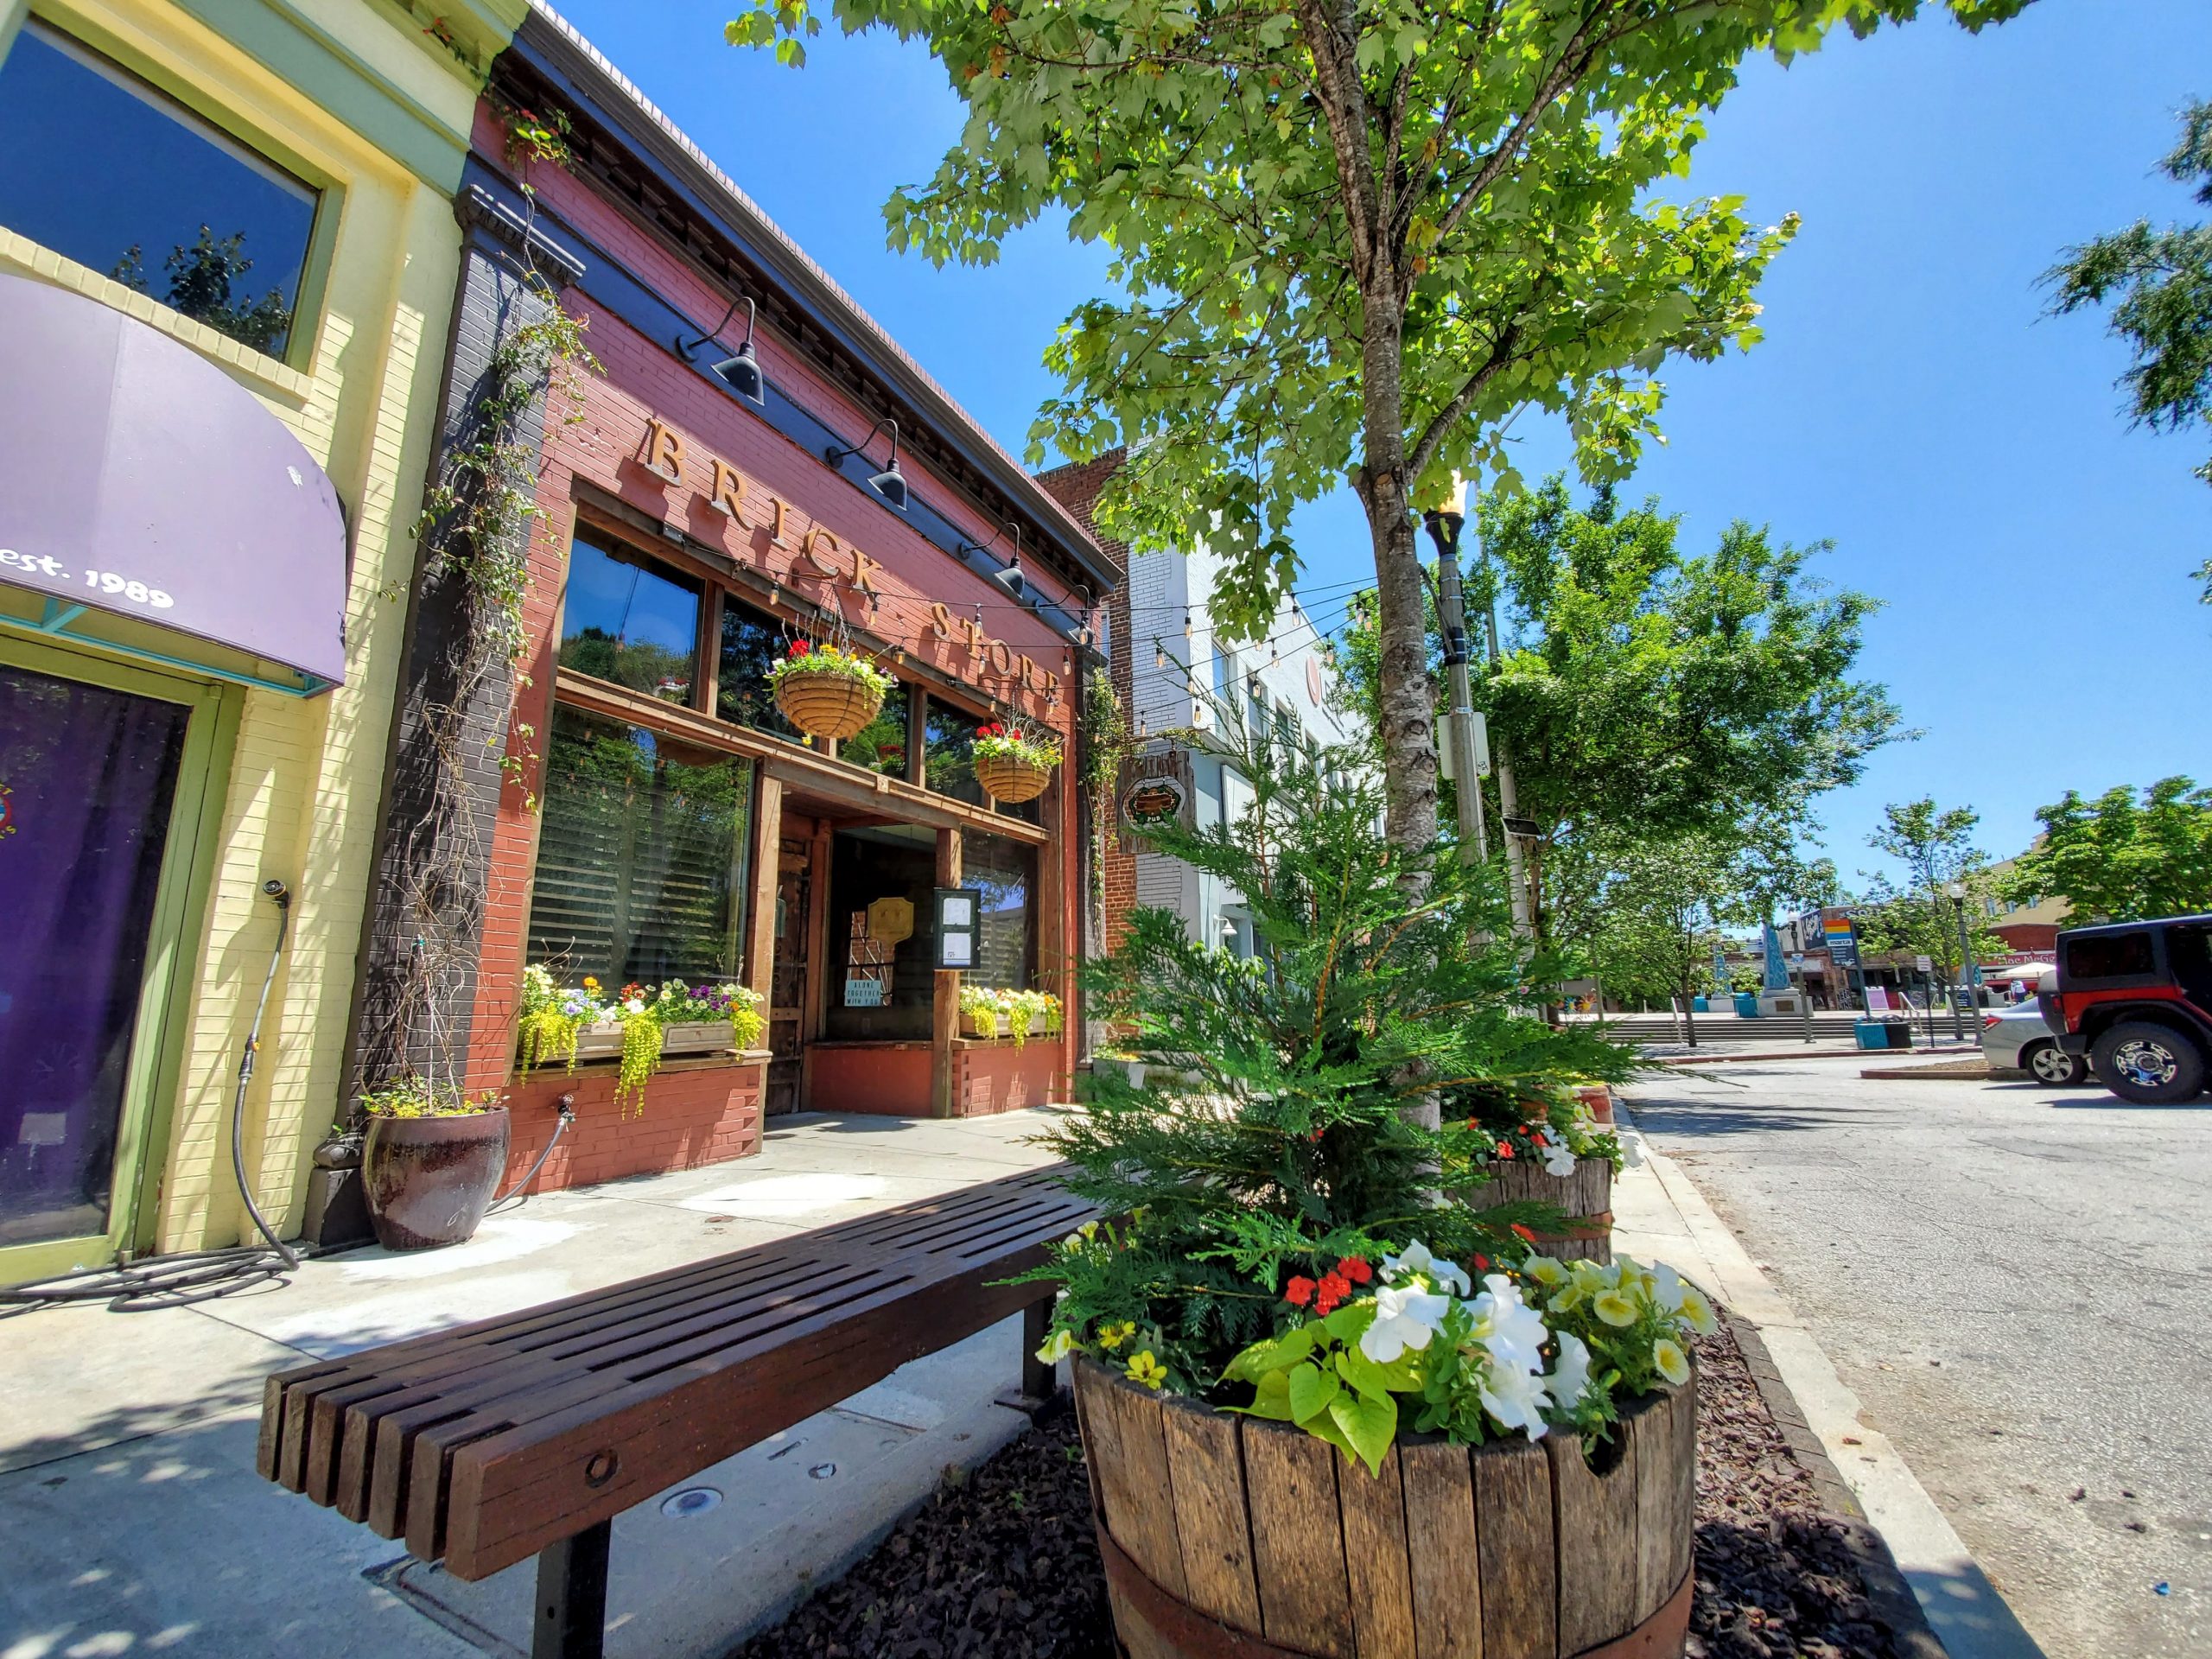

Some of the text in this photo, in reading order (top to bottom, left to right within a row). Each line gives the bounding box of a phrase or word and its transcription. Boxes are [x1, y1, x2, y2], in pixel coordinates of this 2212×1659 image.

[0, 549, 174, 608] est. 1989
[645, 417, 1059, 707] BRICK STORE
[2024, 955, 2056, 963] McGe
